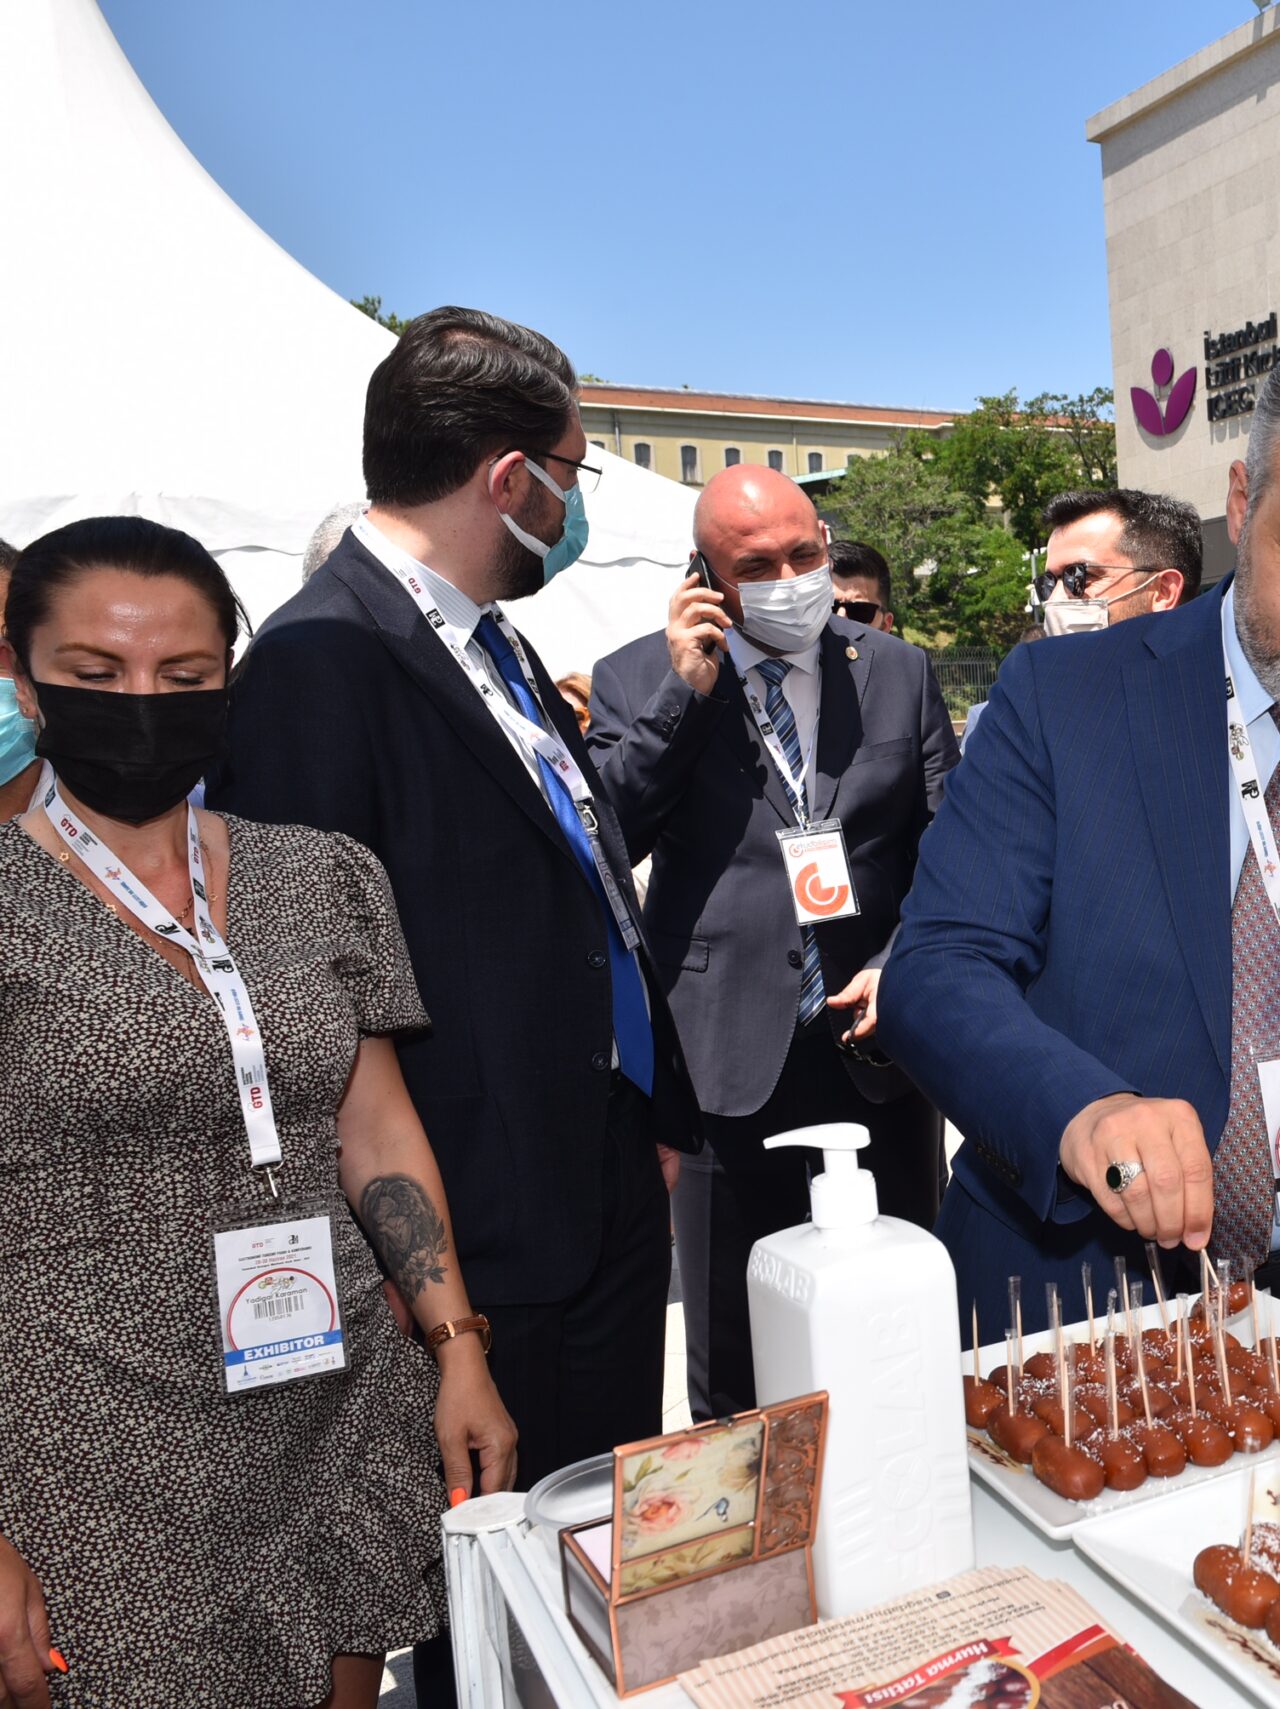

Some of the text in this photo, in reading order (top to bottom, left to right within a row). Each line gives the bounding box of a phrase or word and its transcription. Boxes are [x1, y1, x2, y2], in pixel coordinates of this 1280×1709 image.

[60, 817, 78, 838] GTD
[250, 1086, 263, 1109] GTD
[244, 1335, 325, 1361] EXHIBITOR
[925, 1642, 988, 1676] Hurma
